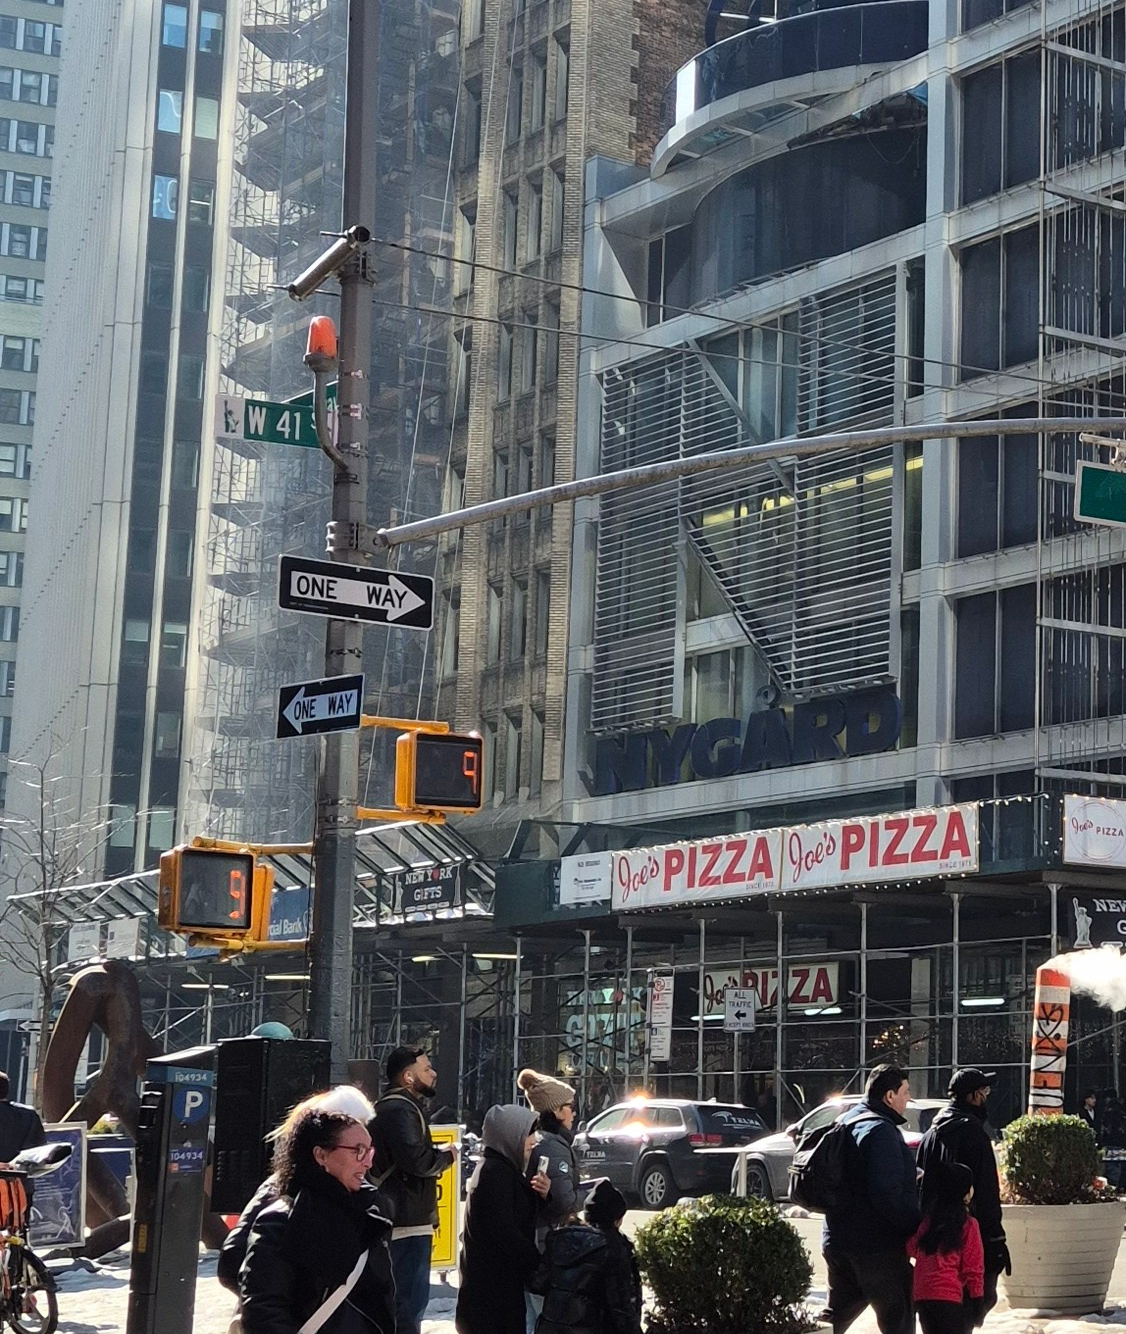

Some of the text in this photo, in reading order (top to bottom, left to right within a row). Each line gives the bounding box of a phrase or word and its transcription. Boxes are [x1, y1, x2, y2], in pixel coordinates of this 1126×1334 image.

[248, 405, 266, 436] W
[276, 411, 301, 441] 41
[296, 575, 407, 609] ONE WAY
[294, 693, 352, 721] ONE WAY
[1071, 817, 1124, 838] Joe's PIZZA
[789, 811, 972, 883] Joe's PIZZA
[405, 869, 426, 885] NEW
[618, 855, 660, 903] Joe's
[663, 836, 774, 891] PIZZA
[413, 885, 442, 901] GIFTS
[728, 1000, 752, 1008] TRAFFIC
[734, 990, 746, 999] ALL
[184, 1090, 204, 1118] P
